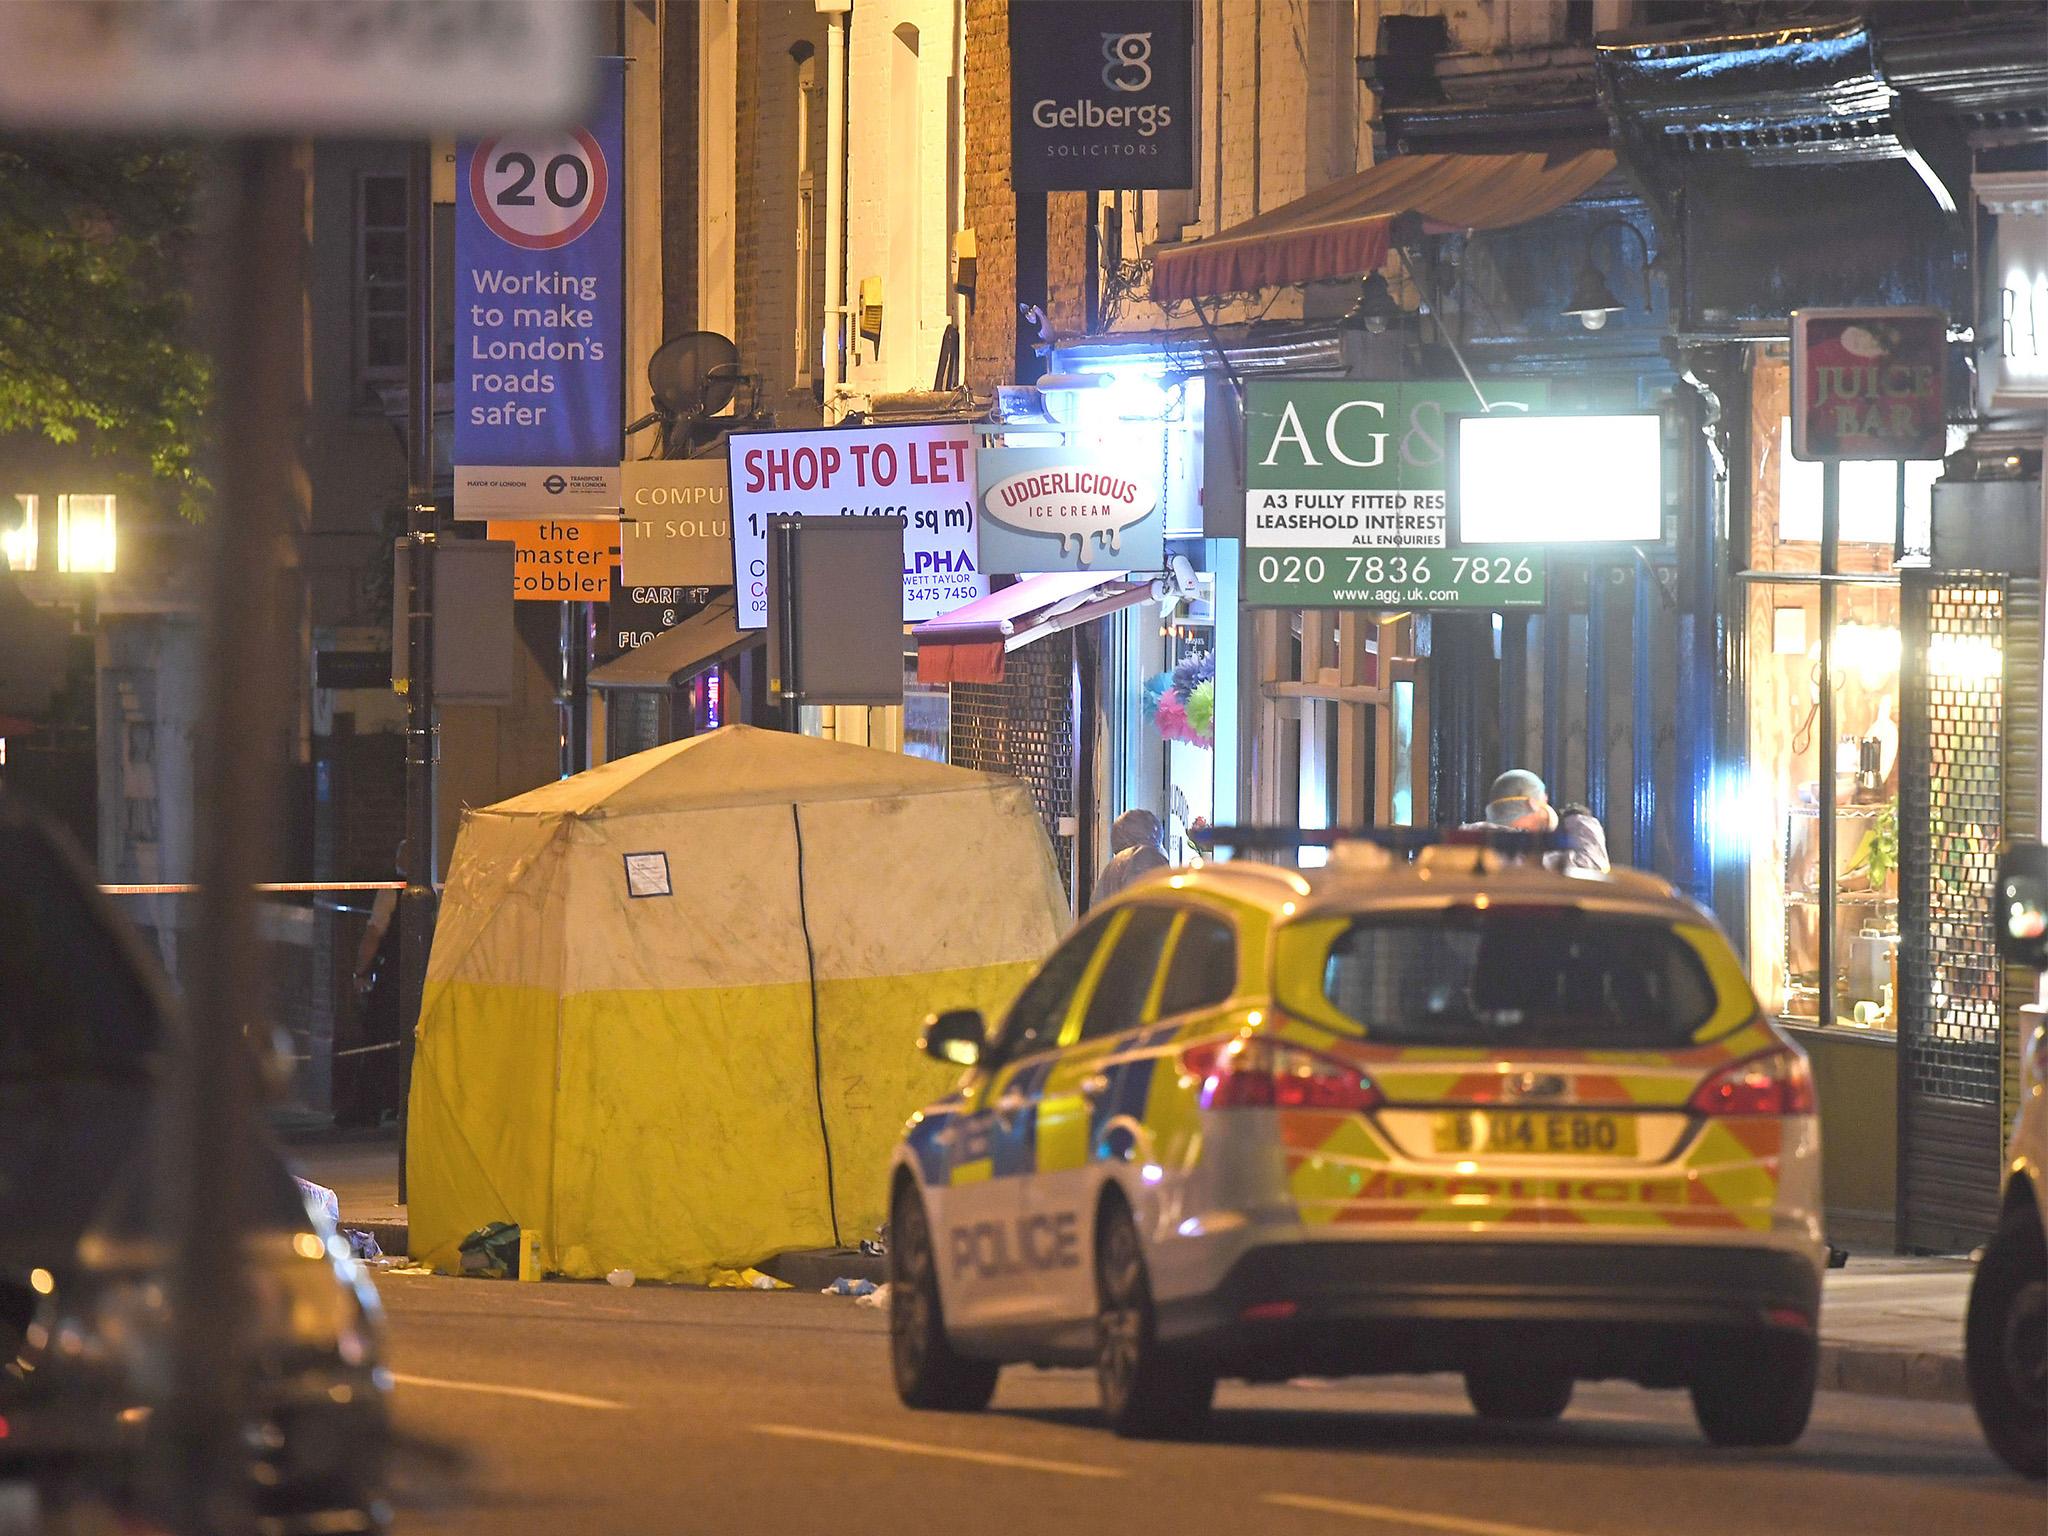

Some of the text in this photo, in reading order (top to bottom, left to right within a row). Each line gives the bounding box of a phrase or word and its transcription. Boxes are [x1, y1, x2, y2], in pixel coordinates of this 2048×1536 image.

[1032, 99, 1171, 137] Gelbergs
[1047, 144, 1158, 157] SOLICITORS
[495, 152, 588, 208] 20
[472, 269, 597, 300] Working
[471, 304, 593, 327] to make
[472, 335, 604, 360] London's
[472, 369, 555, 393] roads
[1814, 366, 1933, 407] JUICE
[471, 402, 547, 425] safer
[1835, 405, 1918, 438] BAR
[1258, 400, 1390, 467] AG
[745, 440, 969, 493] SHOP TO LET
[1001, 472, 1137, 507] UDDERLICIOUS
[1029, 505, 1111, 517] ICE CREAM
[1263, 494, 1444, 509] A3 FULLY FITTED RES
[914, 510, 939, 534] sq
[944, 501, 973, 533] m)
[1257, 515, 1446, 530] LEASEHOLD INTEREST
[539, 522, 579, 541] the
[635, 521, 726, 538] IT SOLU
[1352, 535, 1440, 546] ALL ENQUIRIES
[516, 547, 603, 565] master
[933, 573, 970, 584] TAYLOR
[1258, 556, 1532, 584] 020 7836 7826
[908, 586, 977, 601] 3475 7450
[1333, 589, 1459, 604] www.agg.uk.com
[662, 609, 676, 626] &
[952, 1212, 1080, 1279] POLICE
